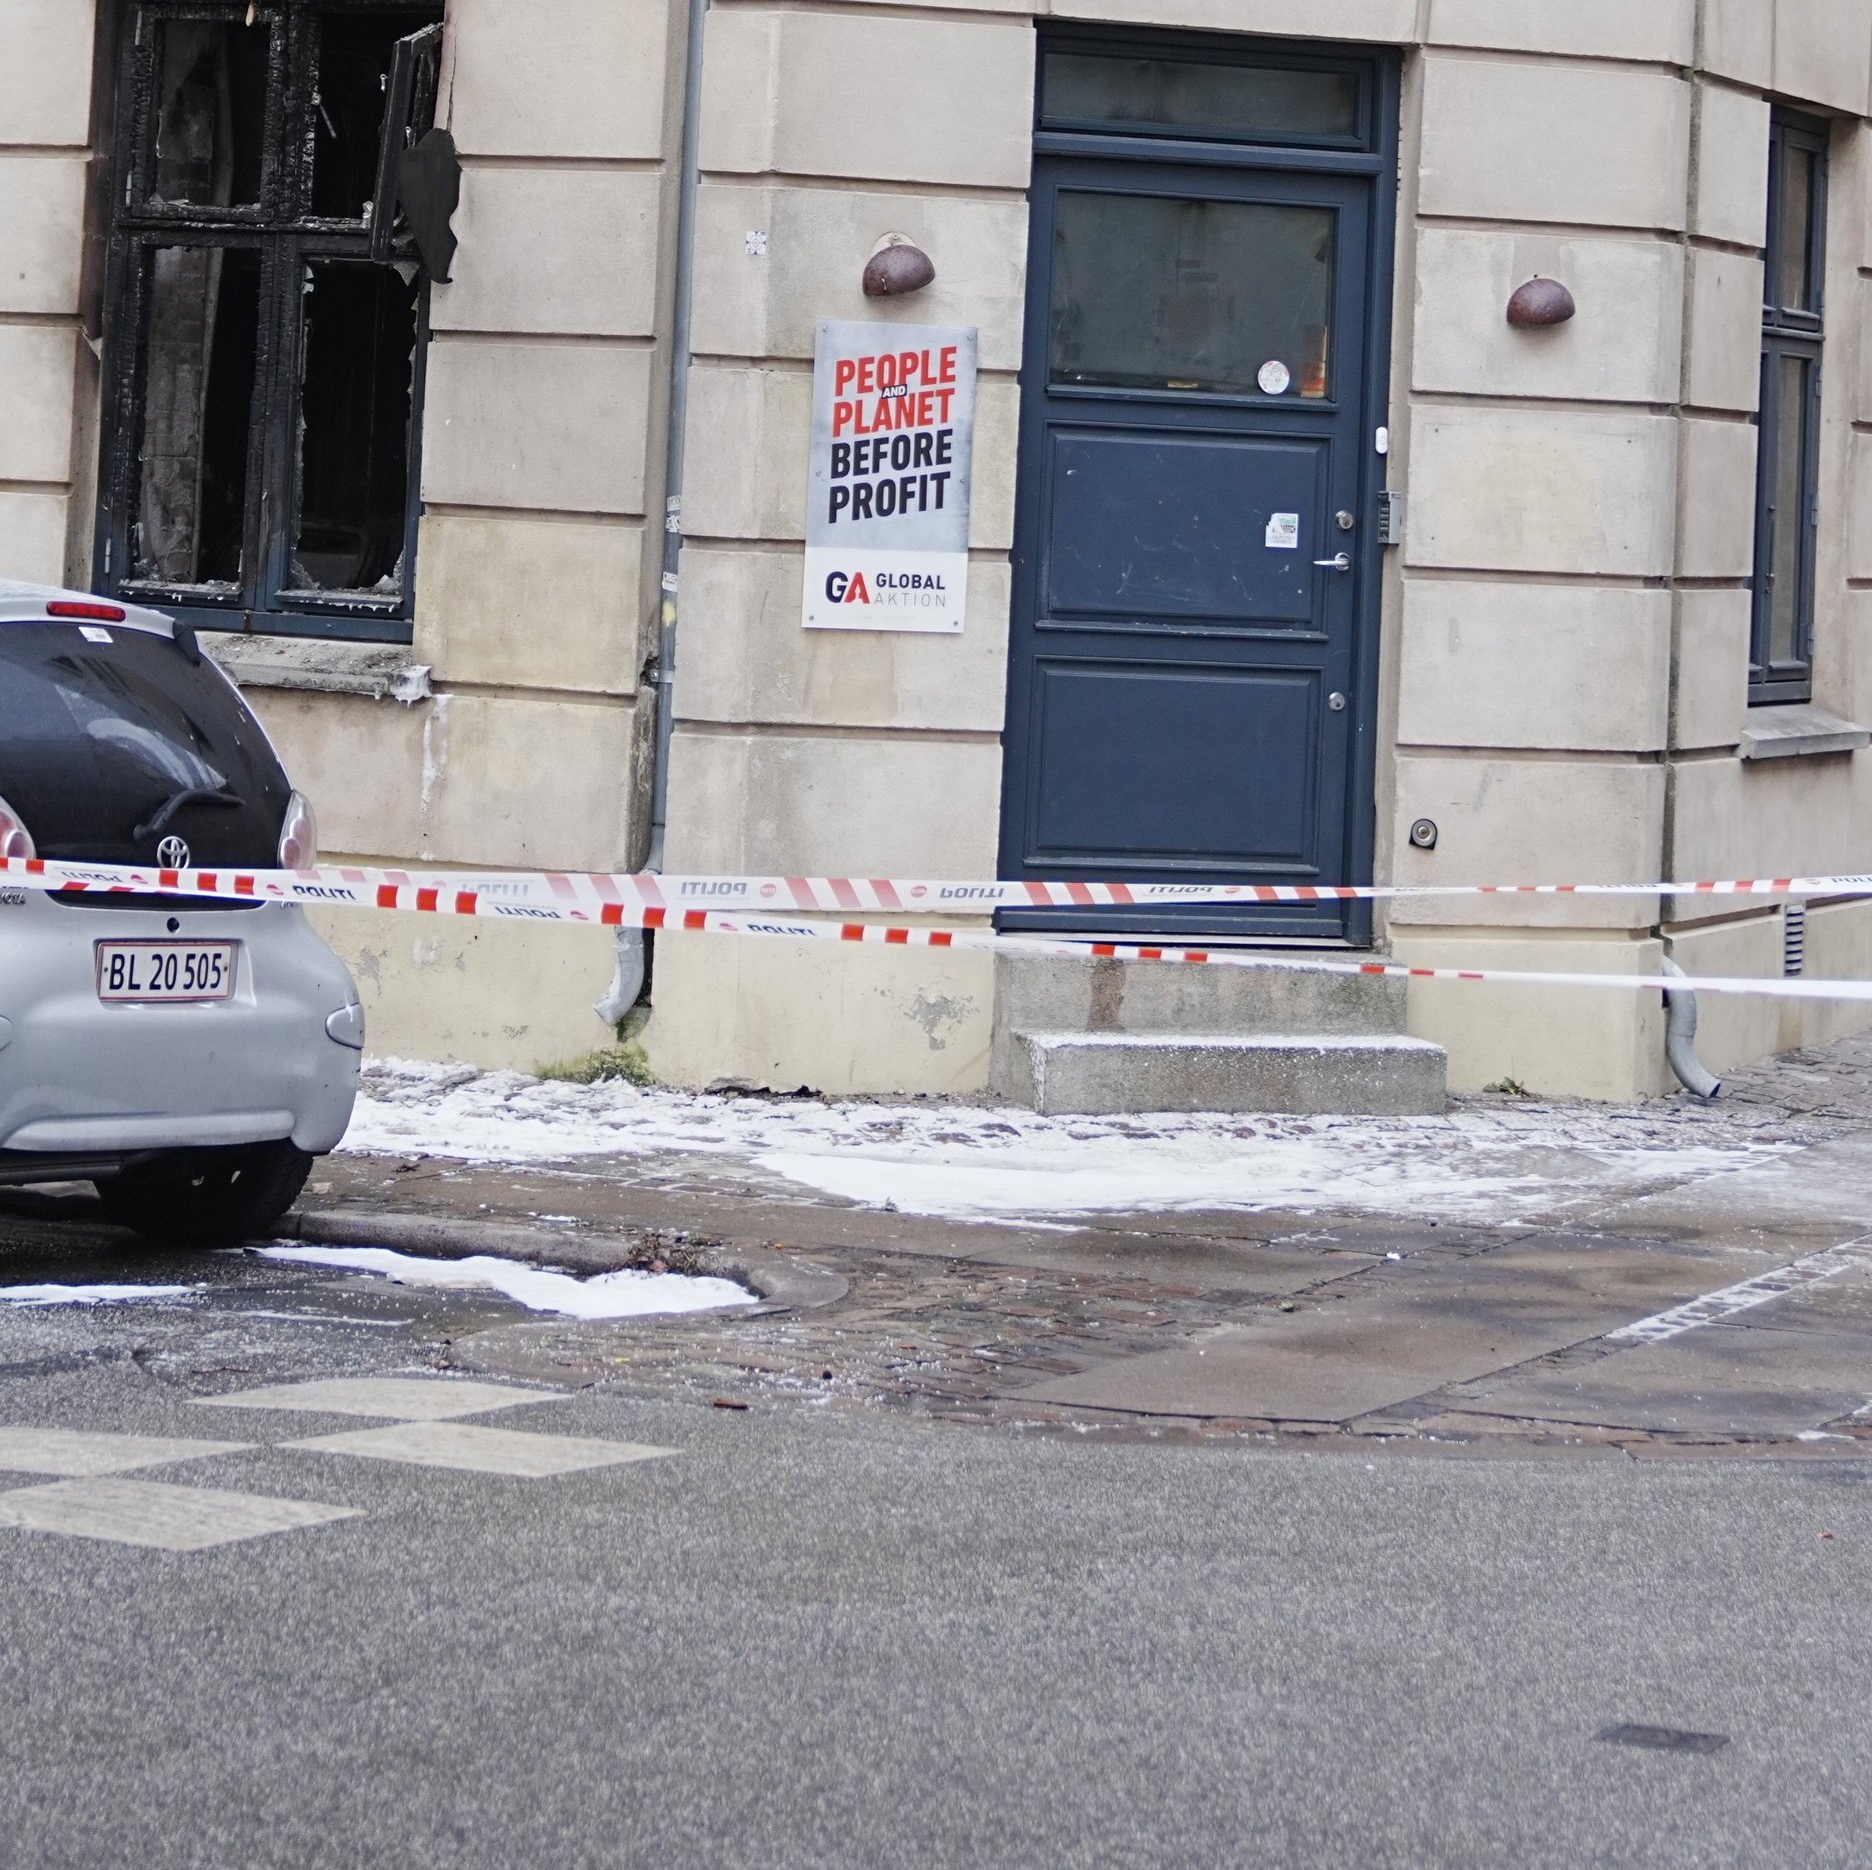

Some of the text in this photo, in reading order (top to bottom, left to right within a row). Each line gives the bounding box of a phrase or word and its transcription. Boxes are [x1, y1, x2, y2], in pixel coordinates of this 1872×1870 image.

[835, 346, 957, 397] PEOPLE
[882, 385, 906, 398] AND
[832, 388, 955, 437] PLANET
[830, 428, 953, 479] BEFORE
[828, 471, 951, 524] PROFIT
[825, 571, 945, 604] GA GLOBAL
[874, 592, 946, 608] AKTION
[109, 953, 222, 990] BL 20 505
